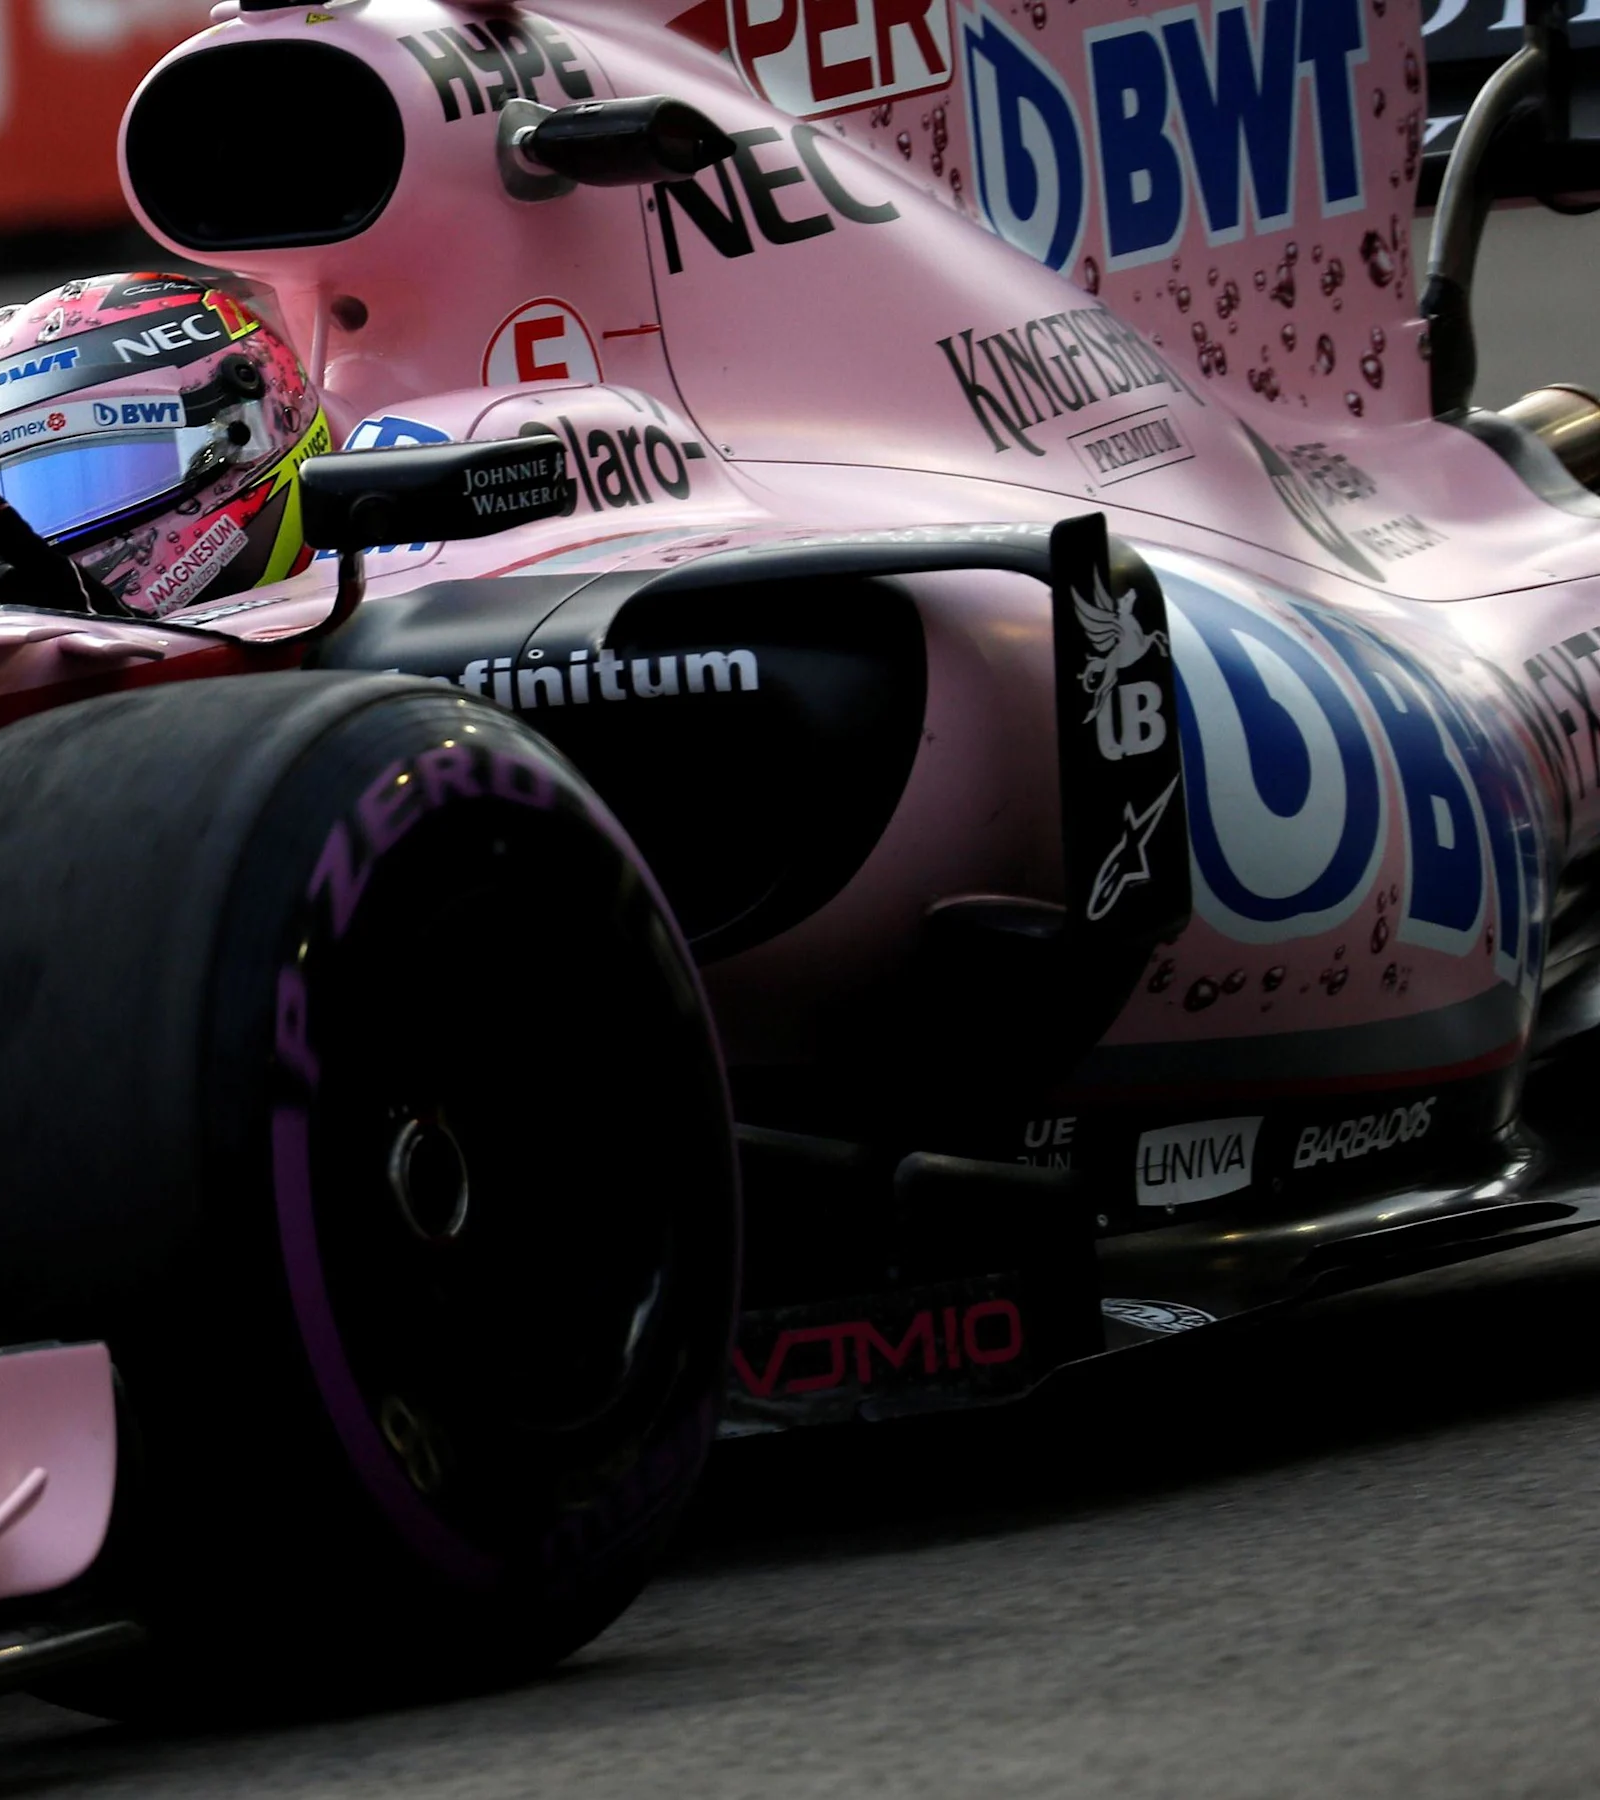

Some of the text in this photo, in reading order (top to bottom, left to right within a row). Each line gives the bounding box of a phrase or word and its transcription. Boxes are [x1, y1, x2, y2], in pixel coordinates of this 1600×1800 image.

[396, 17, 595, 122] HYPE
[1089, 0, 1364, 260] BWT
[652, 123, 900, 275] NEC
[112, 314, 221, 363] NEC
[122, 403, 180, 425] BWT
[1084, 418, 1183, 474] PREMIUM
[463, 458, 549, 495] JOHNNIE
[472, 486, 551, 516] WALKER
[149, 516, 237, 605] MAGNESIUM
[306, 744, 557, 942] ZERO
[1143, 1133, 1246, 1187] UNIVA
[1293, 1096, 1438, 1169] BARBADOS
